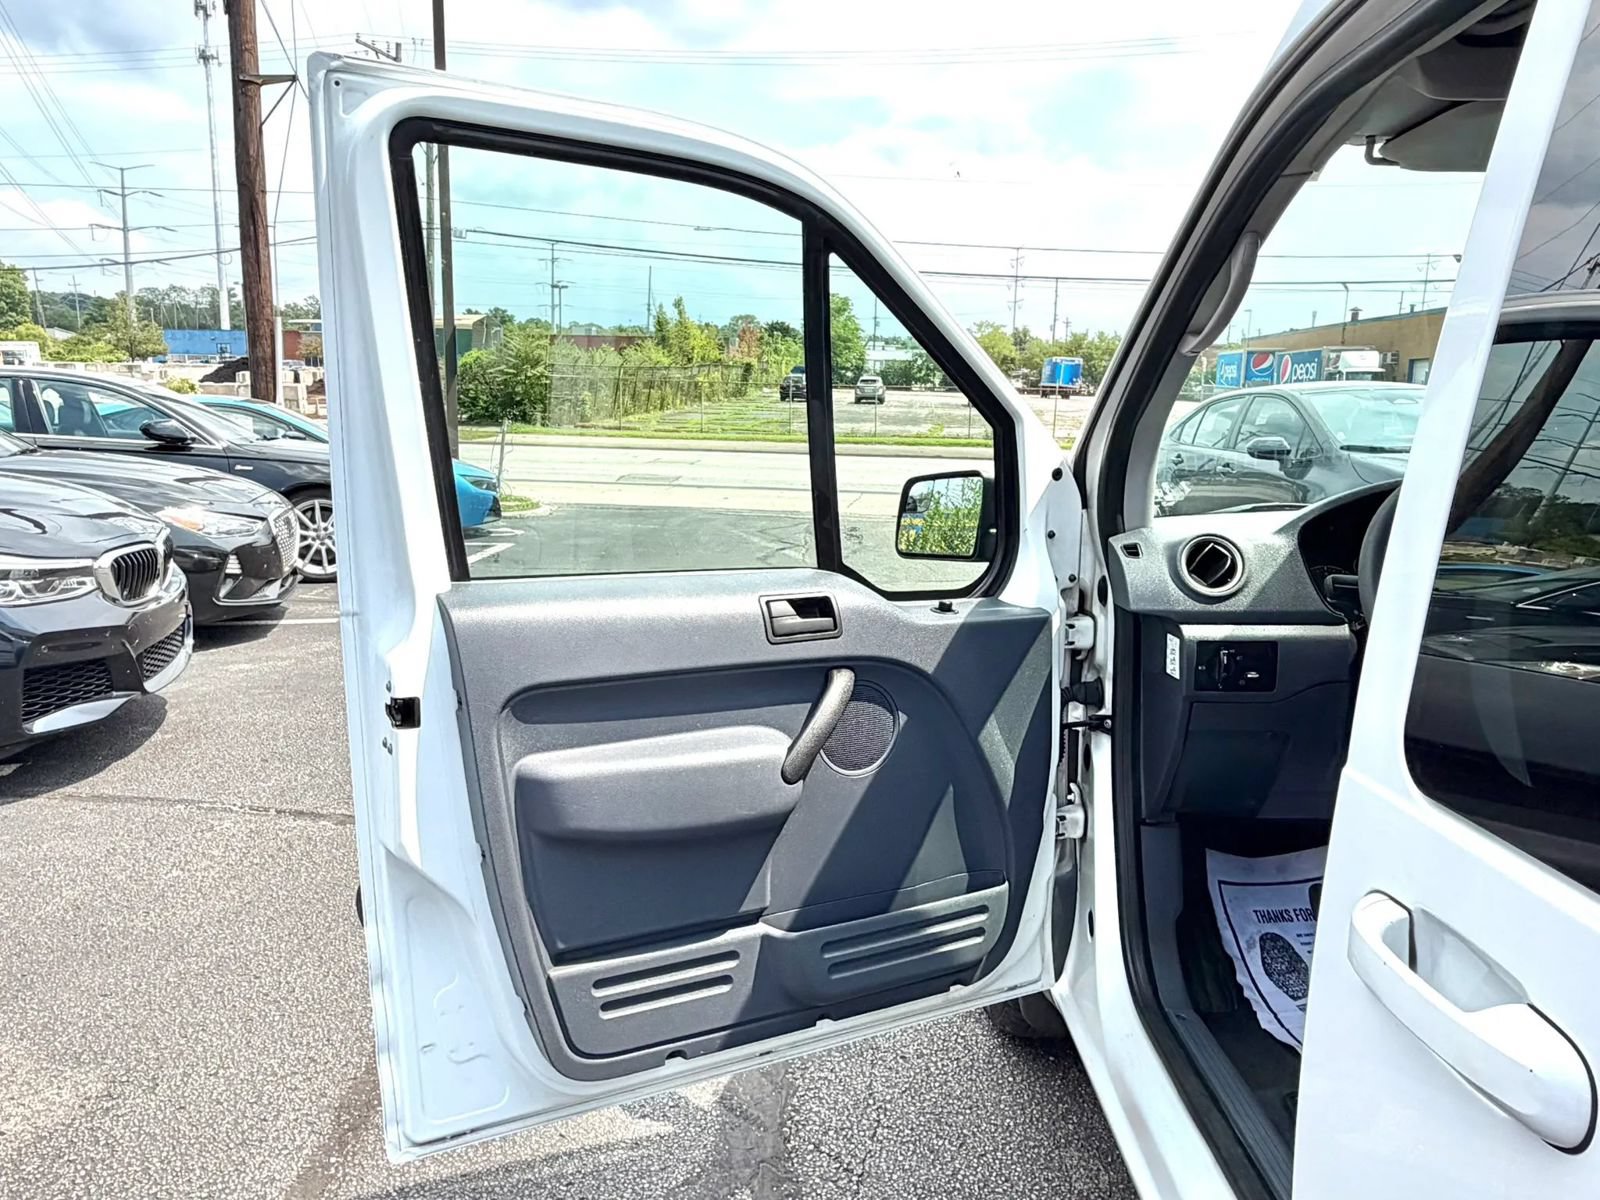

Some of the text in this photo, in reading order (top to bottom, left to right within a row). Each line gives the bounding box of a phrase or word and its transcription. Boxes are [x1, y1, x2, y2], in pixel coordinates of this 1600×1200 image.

[1292, 357, 1318, 383] pepsi
[1252, 907, 1313, 924] THANKS FOR
